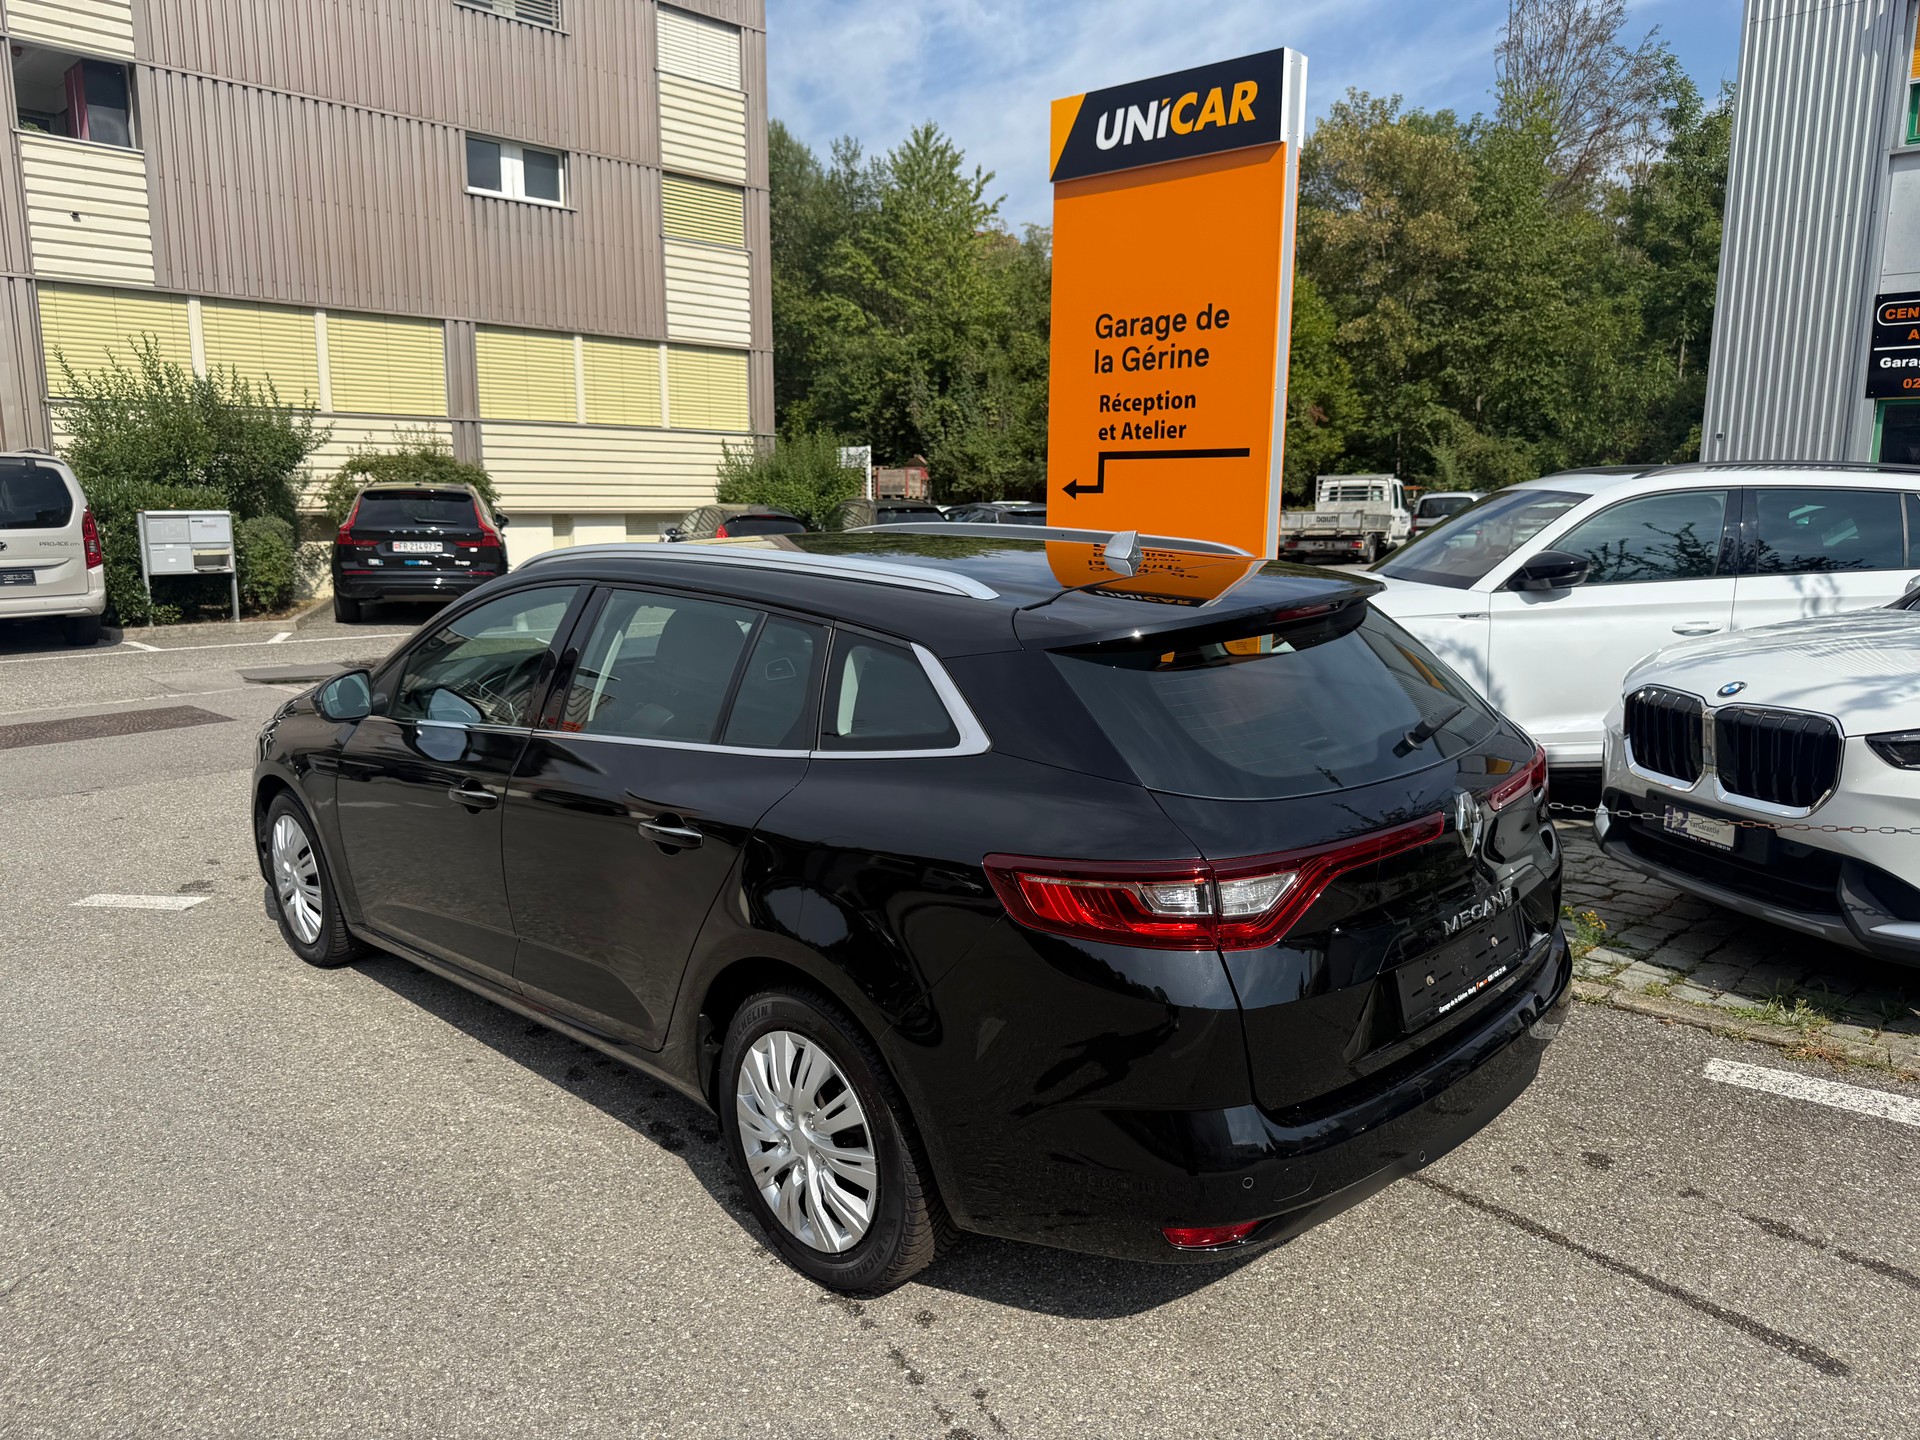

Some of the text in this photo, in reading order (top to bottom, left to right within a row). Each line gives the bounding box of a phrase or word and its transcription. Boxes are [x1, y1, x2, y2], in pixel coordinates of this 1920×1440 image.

[1095, 303, 1230, 341] Garage de
[1094, 342, 1210, 374] la Gérine
[1099, 390, 1197, 416] Réception
[1098, 419, 1187, 441] et Atelier
